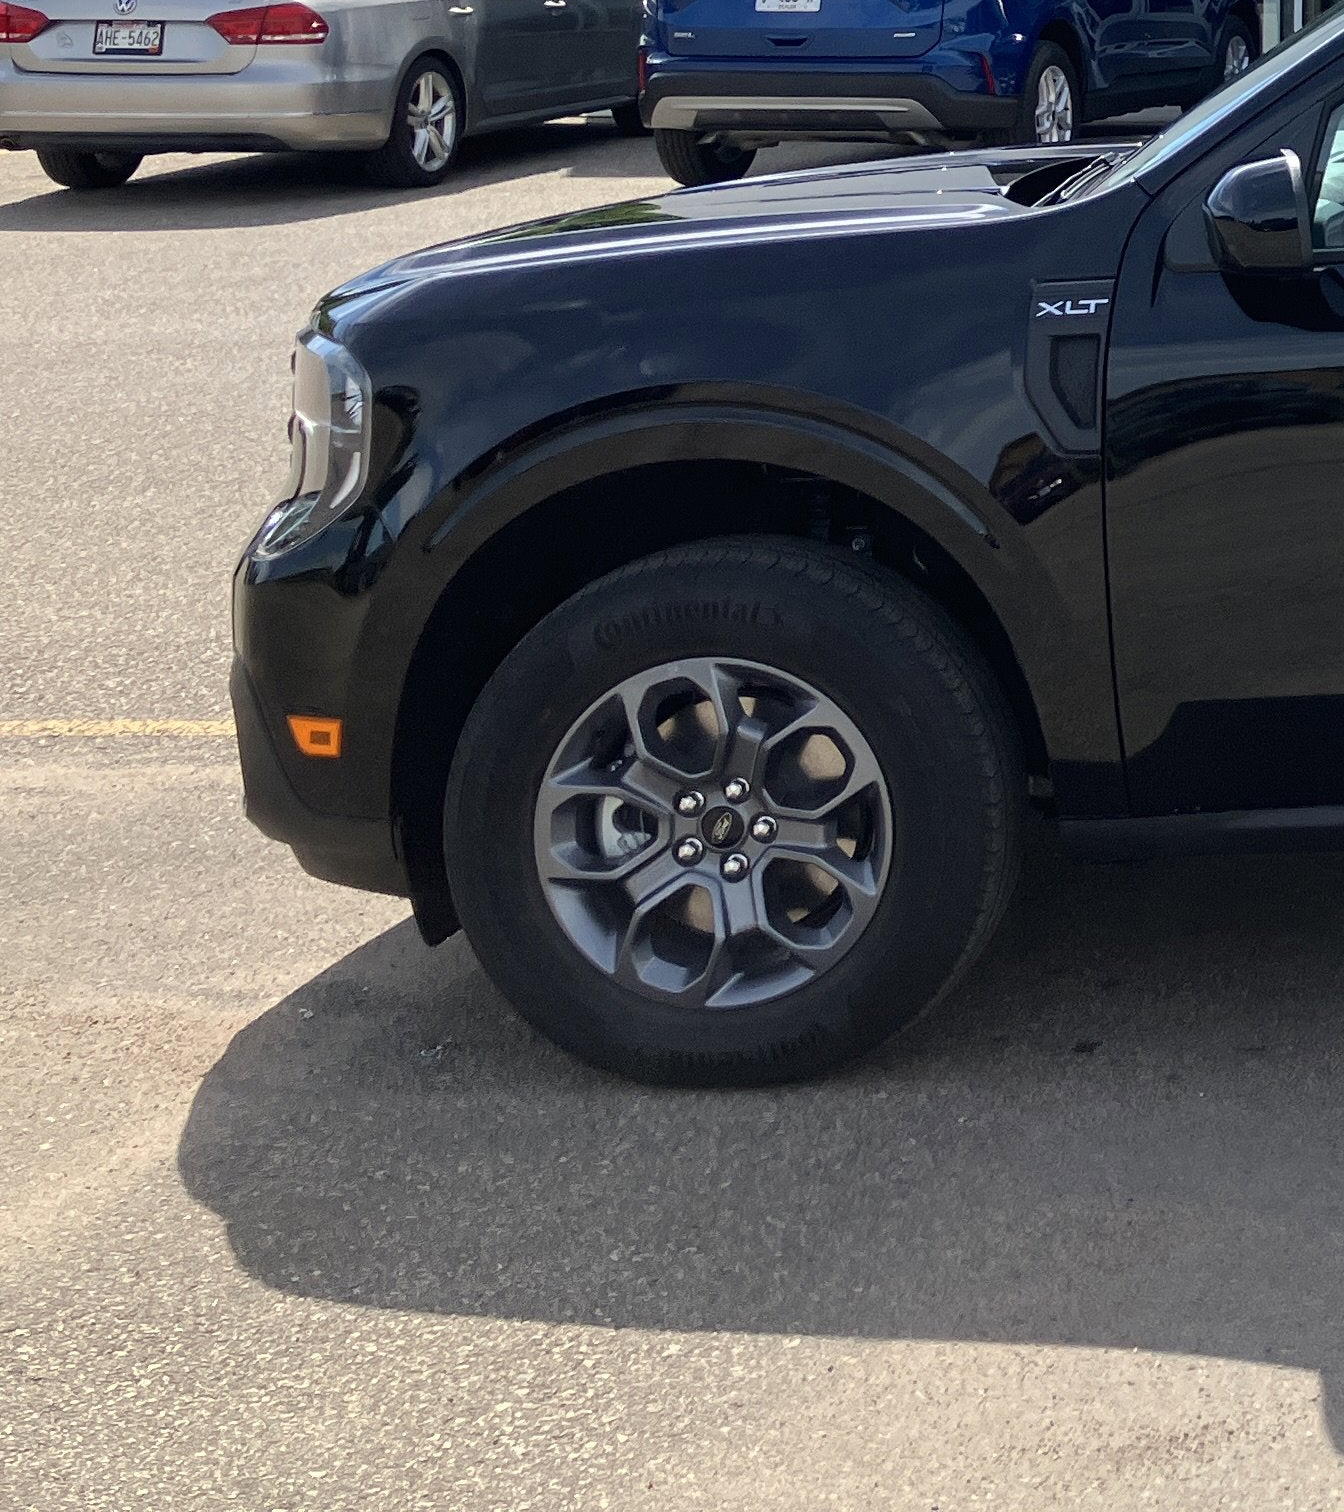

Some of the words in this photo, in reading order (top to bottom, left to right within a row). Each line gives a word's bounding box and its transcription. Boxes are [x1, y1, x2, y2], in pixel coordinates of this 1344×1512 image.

[96, 29, 160, 47] AHE-5462
[1035, 298, 1109, 317] XLT
[593, 599, 761, 648] Continental
